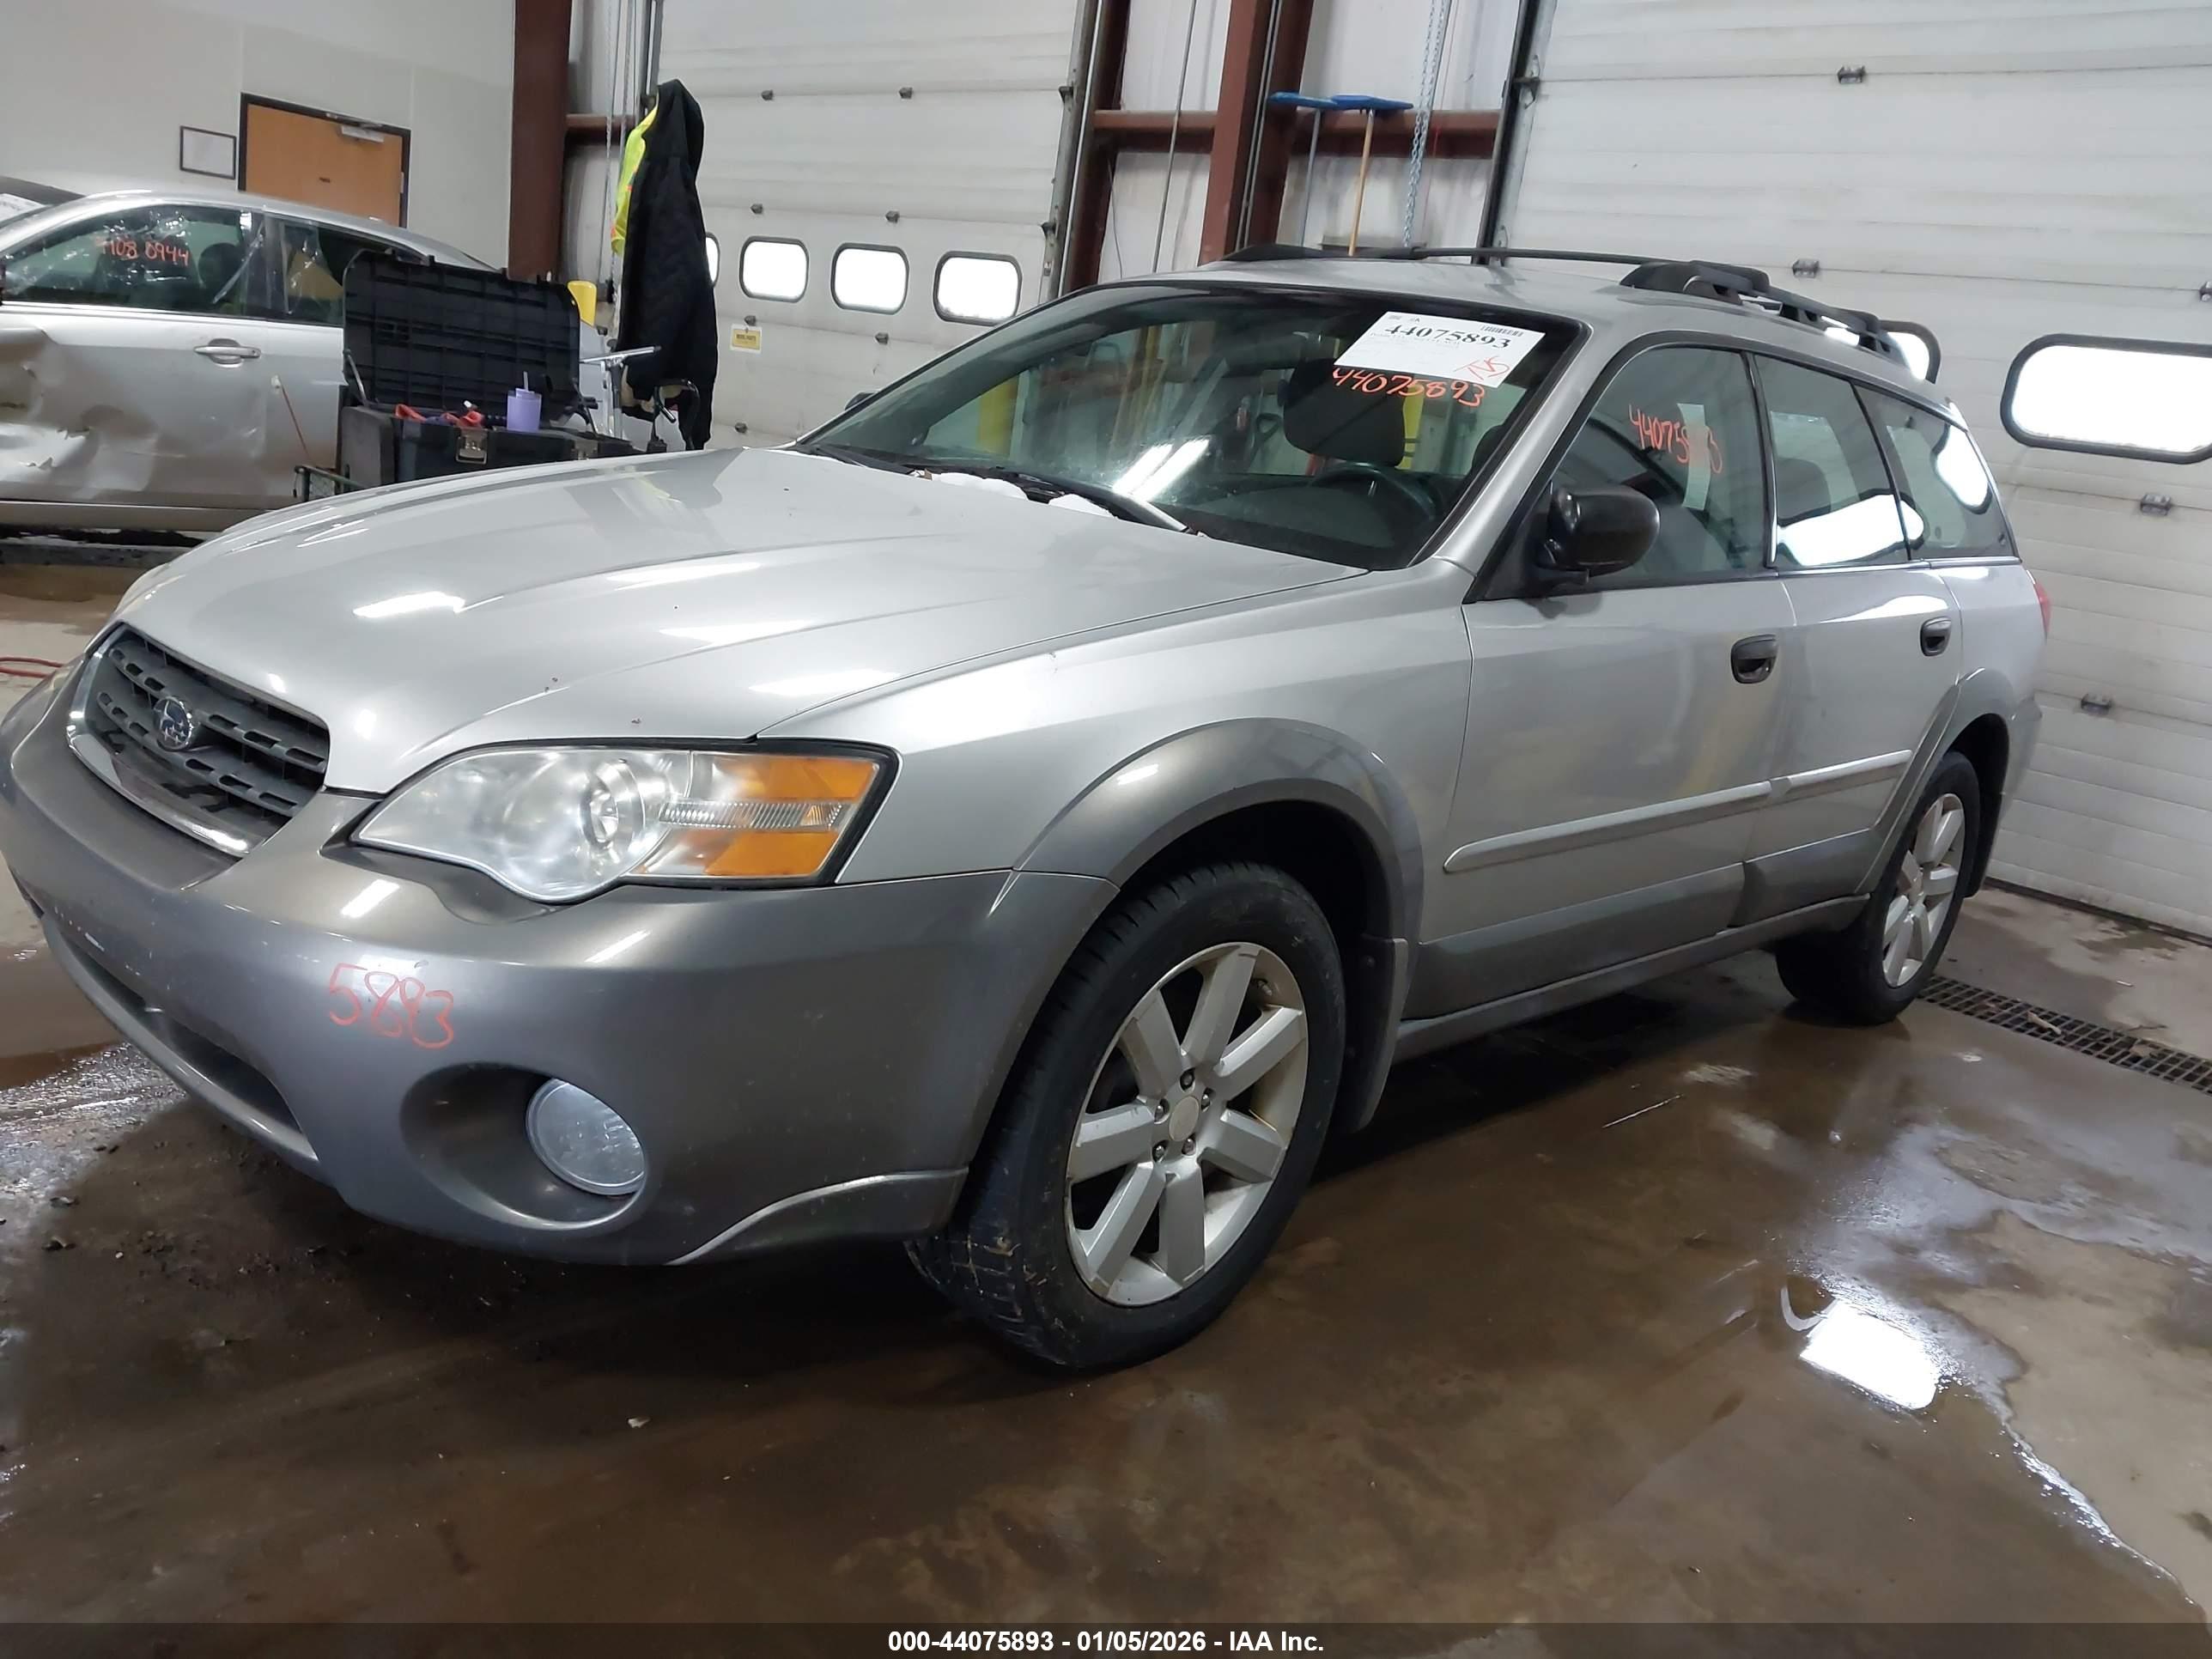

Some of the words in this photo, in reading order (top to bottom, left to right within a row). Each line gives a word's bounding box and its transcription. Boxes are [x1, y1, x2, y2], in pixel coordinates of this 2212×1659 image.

[1385, 323, 1511, 349] 44075893
[1333, 368, 1486, 408] 44075893
[1628, 404, 1723, 474] 440753
